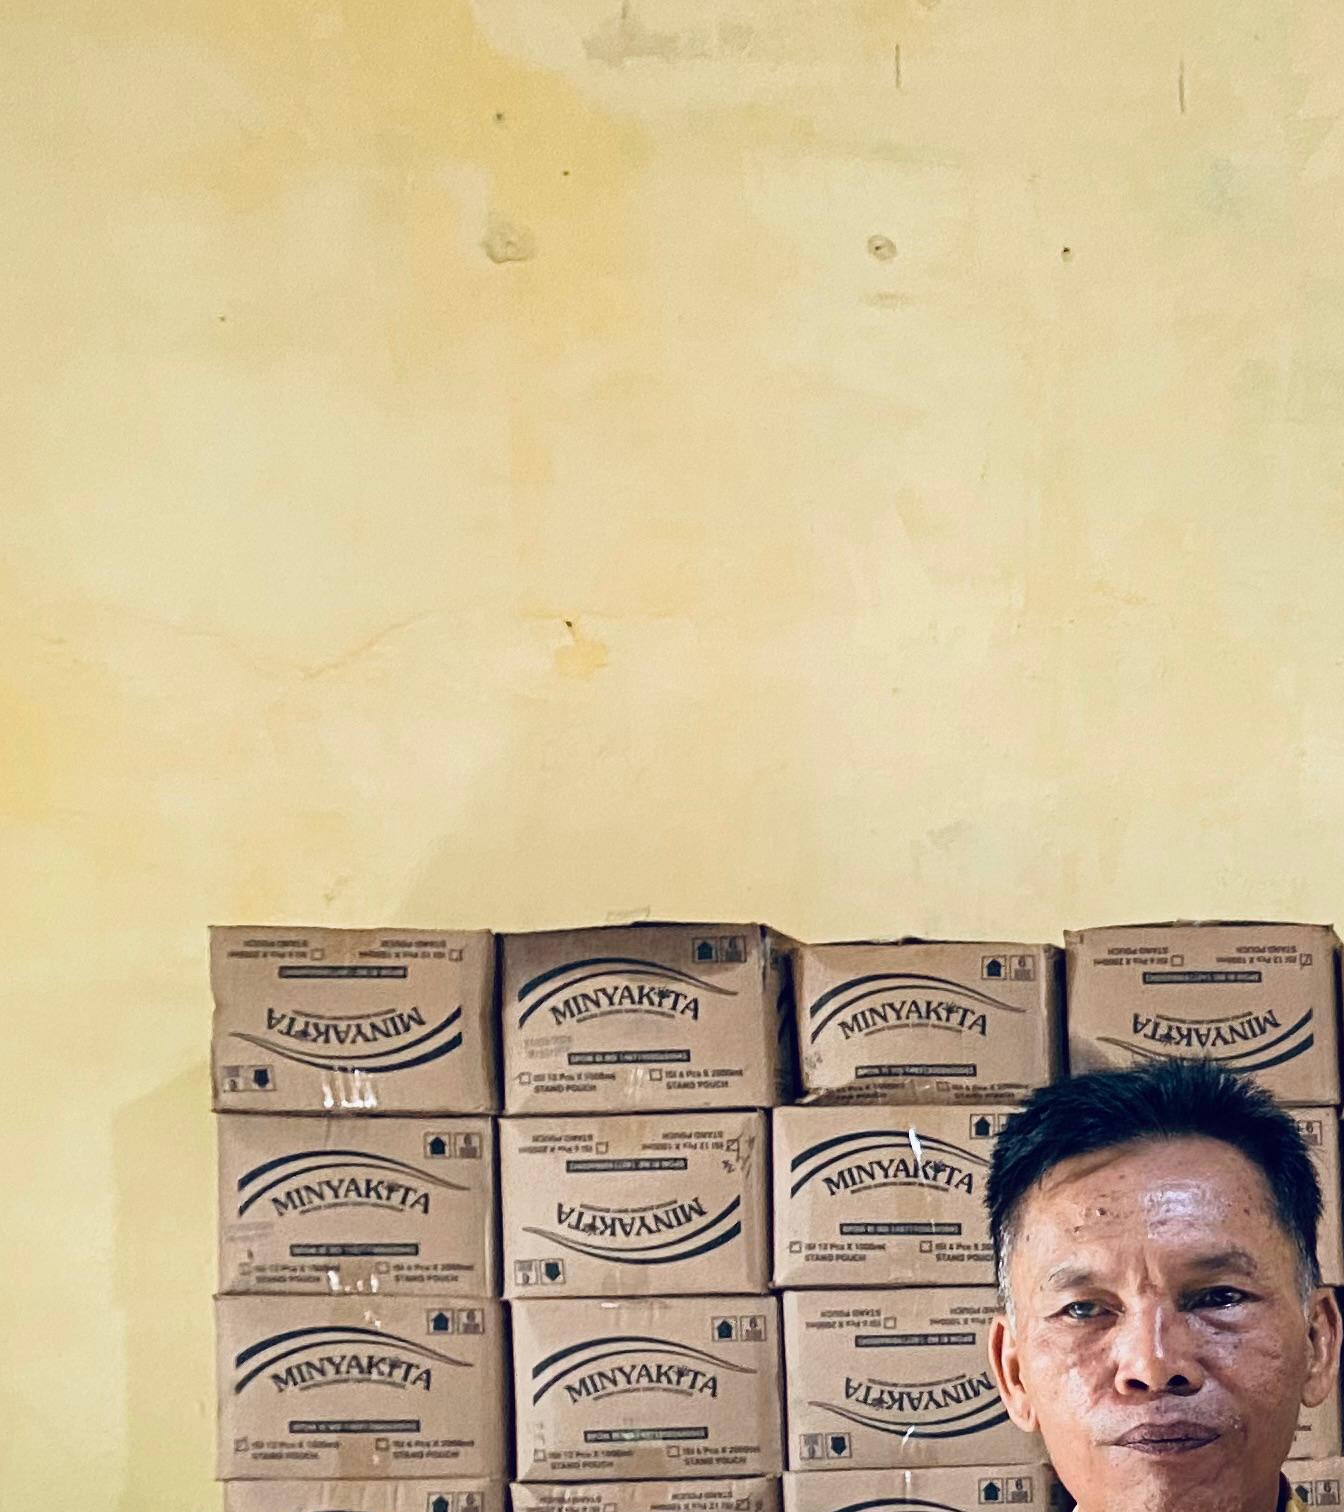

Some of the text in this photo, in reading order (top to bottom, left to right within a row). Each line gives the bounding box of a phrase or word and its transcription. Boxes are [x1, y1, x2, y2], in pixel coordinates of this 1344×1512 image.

[549, 985, 698, 1025] MINYAKITA
[837, 1000, 987, 1040] MINYAKITA
[267, 1006, 426, 1045] MINYAKITA
[1133, 1009, 1281, 1049] MINYAKITA
[822, 1159, 973, 1195] MINYAKITA
[271, 1178, 430, 1217] MINYAKITA
[558, 1197, 708, 1237] MINYAKITA
[271, 1355, 432, 1393] MINYAKITA
[565, 1364, 718, 1404] MINYAKITA
[845, 1371, 995, 1412] MINYAKITA
